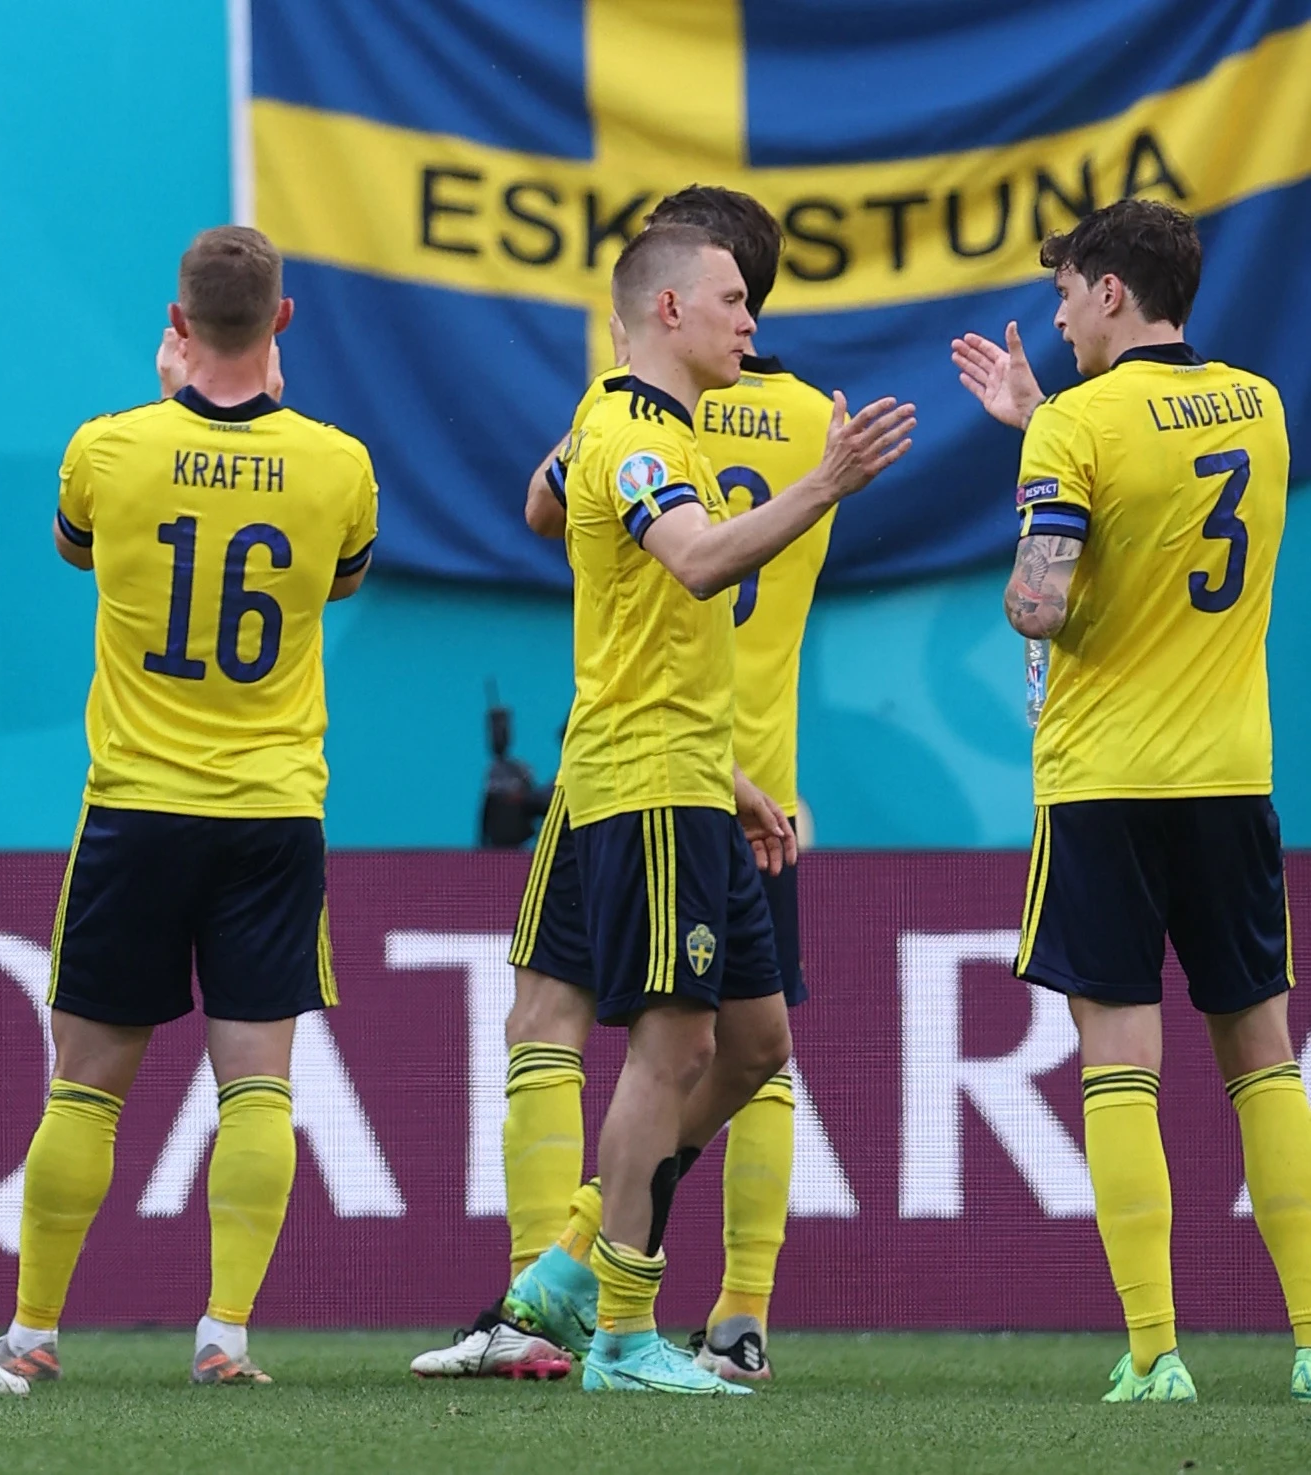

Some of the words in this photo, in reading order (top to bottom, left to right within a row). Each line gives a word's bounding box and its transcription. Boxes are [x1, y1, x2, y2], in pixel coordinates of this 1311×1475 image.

[419, 128, 1188, 282] ESKSTUNA
[704, 400, 790, 442] EKDAL
[1147, 383, 1263, 432] LINDELÖF
[173, 449, 283, 493] KRAFTH
[1025, 483, 1057, 499] RESPECT
[1188, 448, 1250, 613] 3
[143, 516, 292, 683] 16
